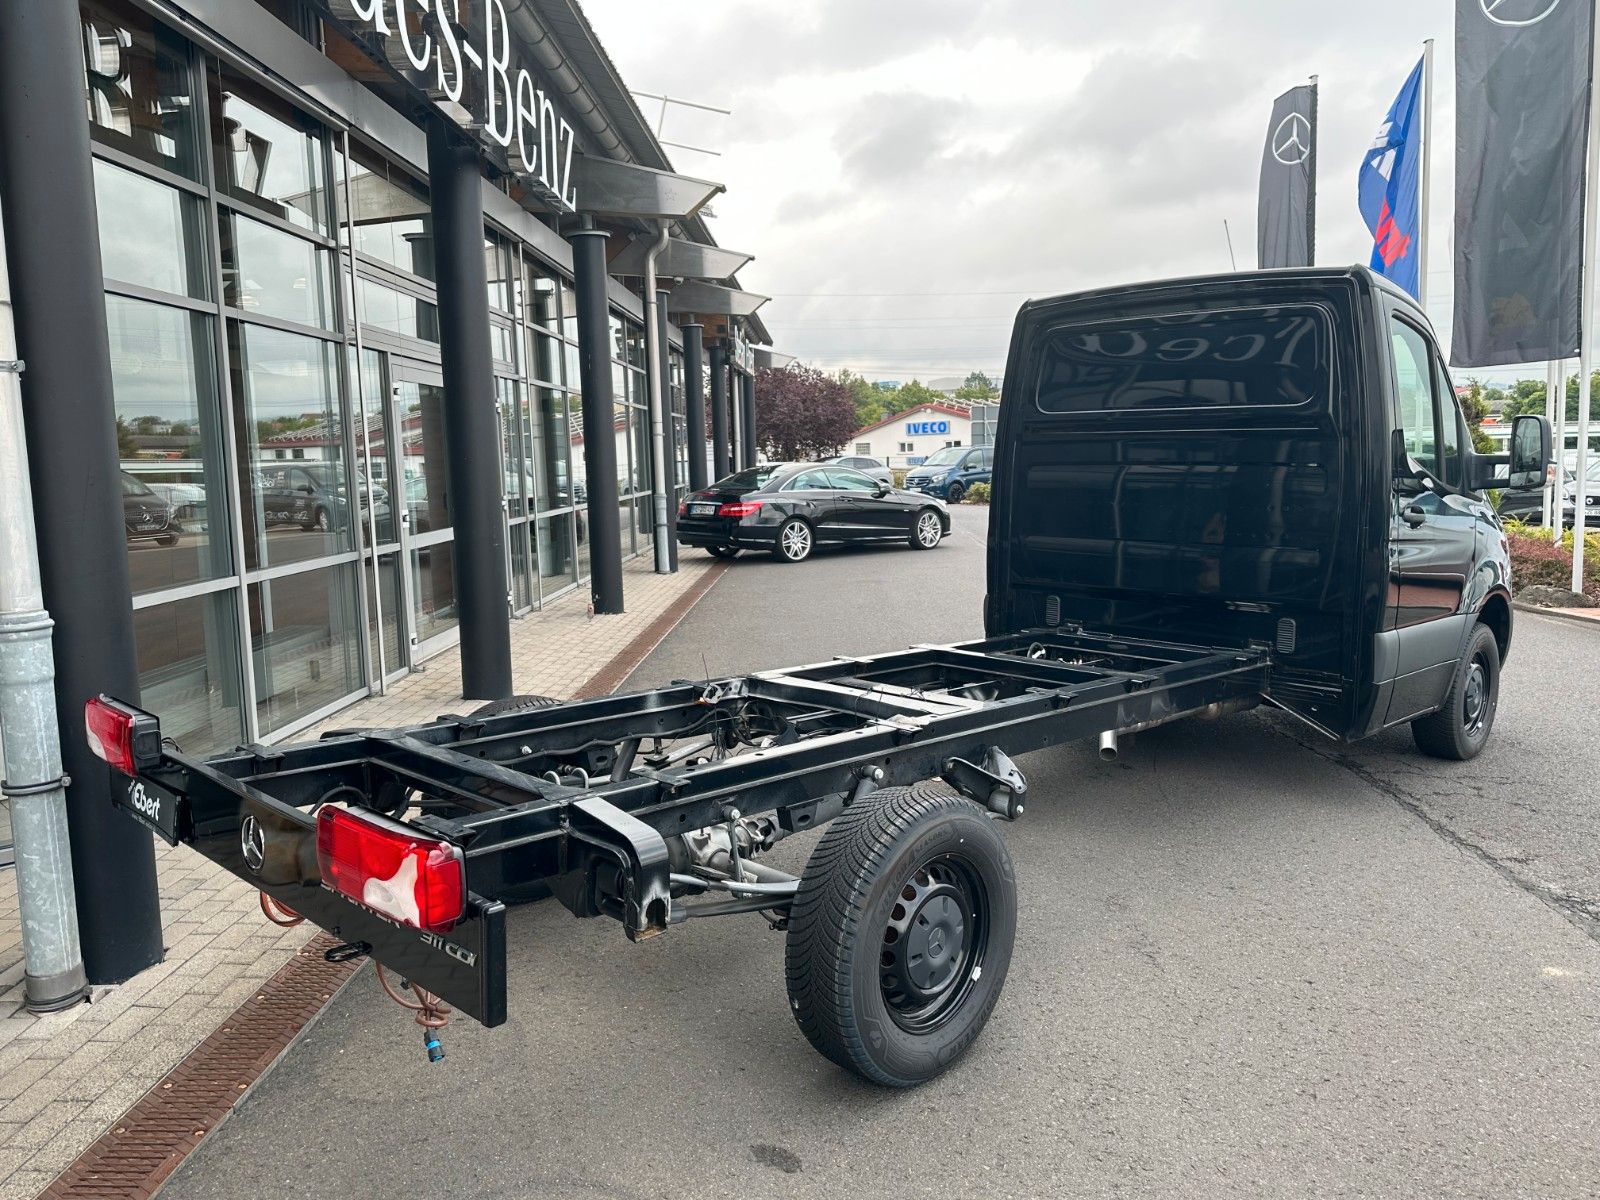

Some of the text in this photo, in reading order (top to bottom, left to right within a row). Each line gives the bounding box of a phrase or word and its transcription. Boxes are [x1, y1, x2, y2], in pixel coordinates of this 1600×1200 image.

[907, 421, 947, 434] IVECO
[419, 929, 478, 967] 311 CDI
